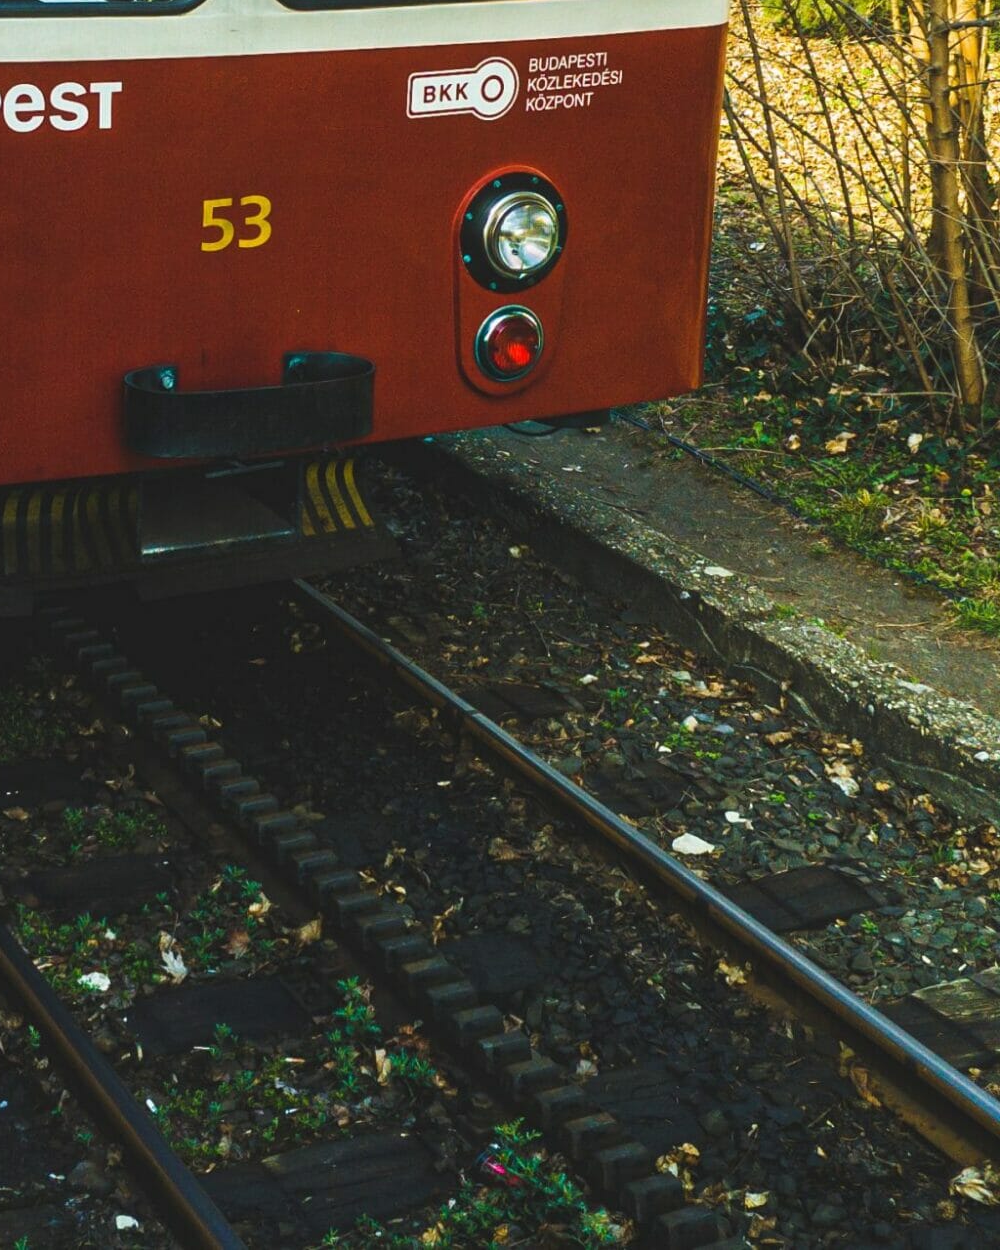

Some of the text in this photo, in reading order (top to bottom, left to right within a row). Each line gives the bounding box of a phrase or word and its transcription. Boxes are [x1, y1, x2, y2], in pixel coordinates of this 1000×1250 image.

[528, 52, 608, 72] BUDAPESTI
[527, 68, 623, 92] KÖZLEKEDÉSI
[423, 82, 469, 104] BKK
[525, 92, 594, 112] KÖZPONT
[201, 195, 272, 252] 53
